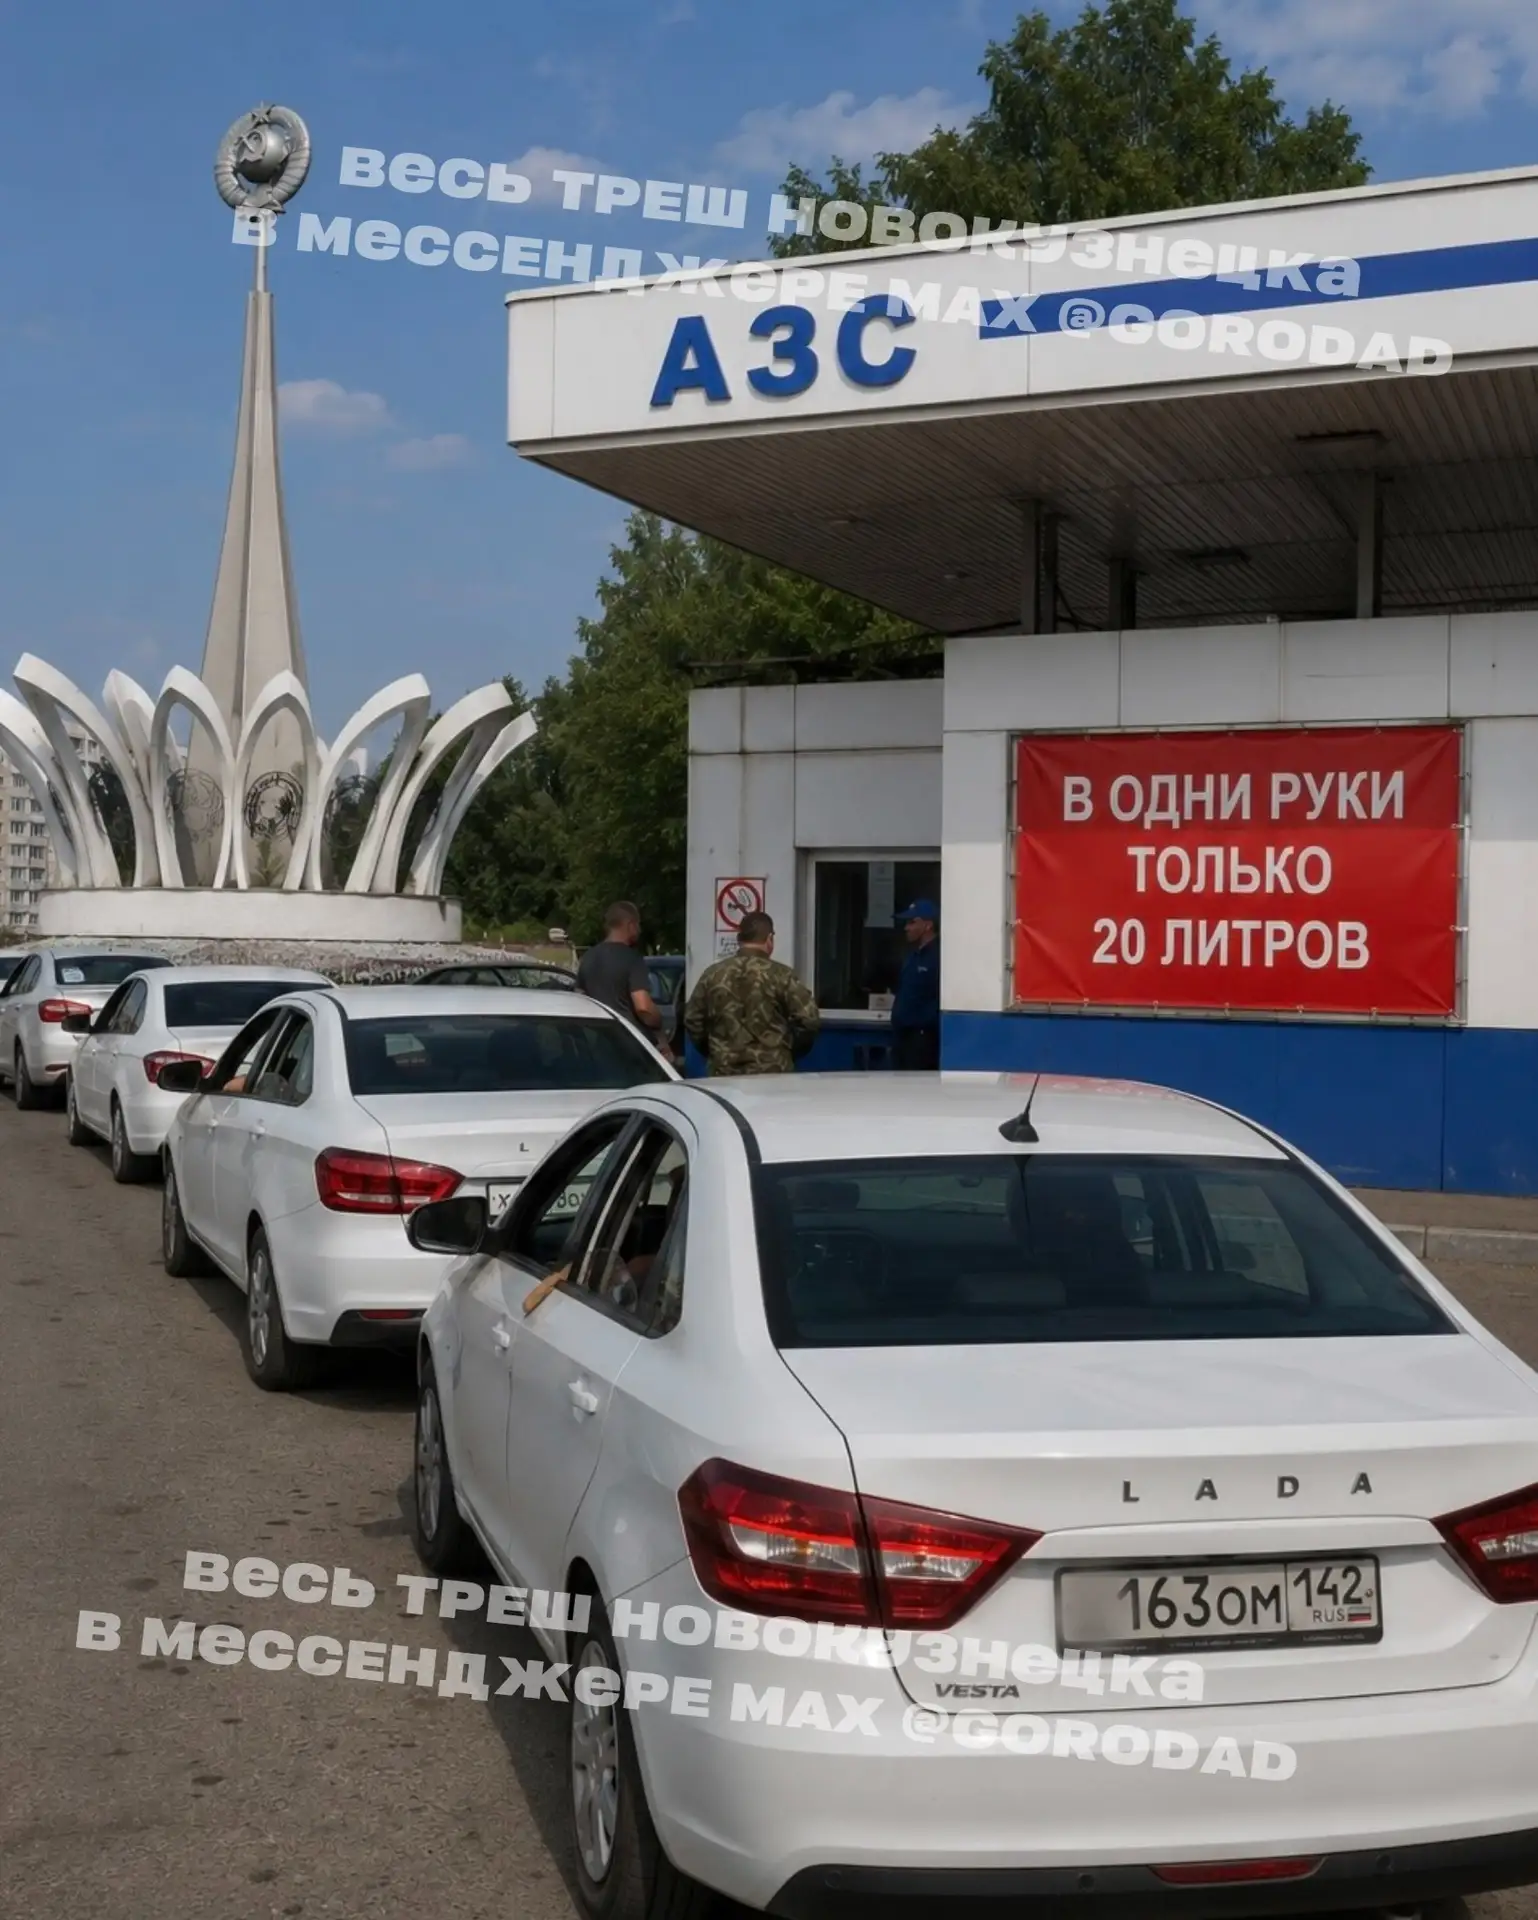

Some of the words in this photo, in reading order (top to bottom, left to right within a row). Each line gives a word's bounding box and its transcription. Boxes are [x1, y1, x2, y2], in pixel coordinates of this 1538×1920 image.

[650, 293, 917, 407] АЗС
[1063, 775, 1094, 822] В
[1109, 773, 1252, 830] ОДНИ
[1270, 770, 1405, 820] РУКИ
[1127, 845, 1332, 895] ТОЛЬКО
[1092, 918, 1145, 965] 20
[1160, 919, 1371, 970] ЛИТРОВ
[1121, 1471, 1373, 1503] LADA
[1292, 1564, 1365, 1609] 142
[1312, 1606, 1346, 1624] RUS
[934, 1682, 1020, 1699] VESTA
